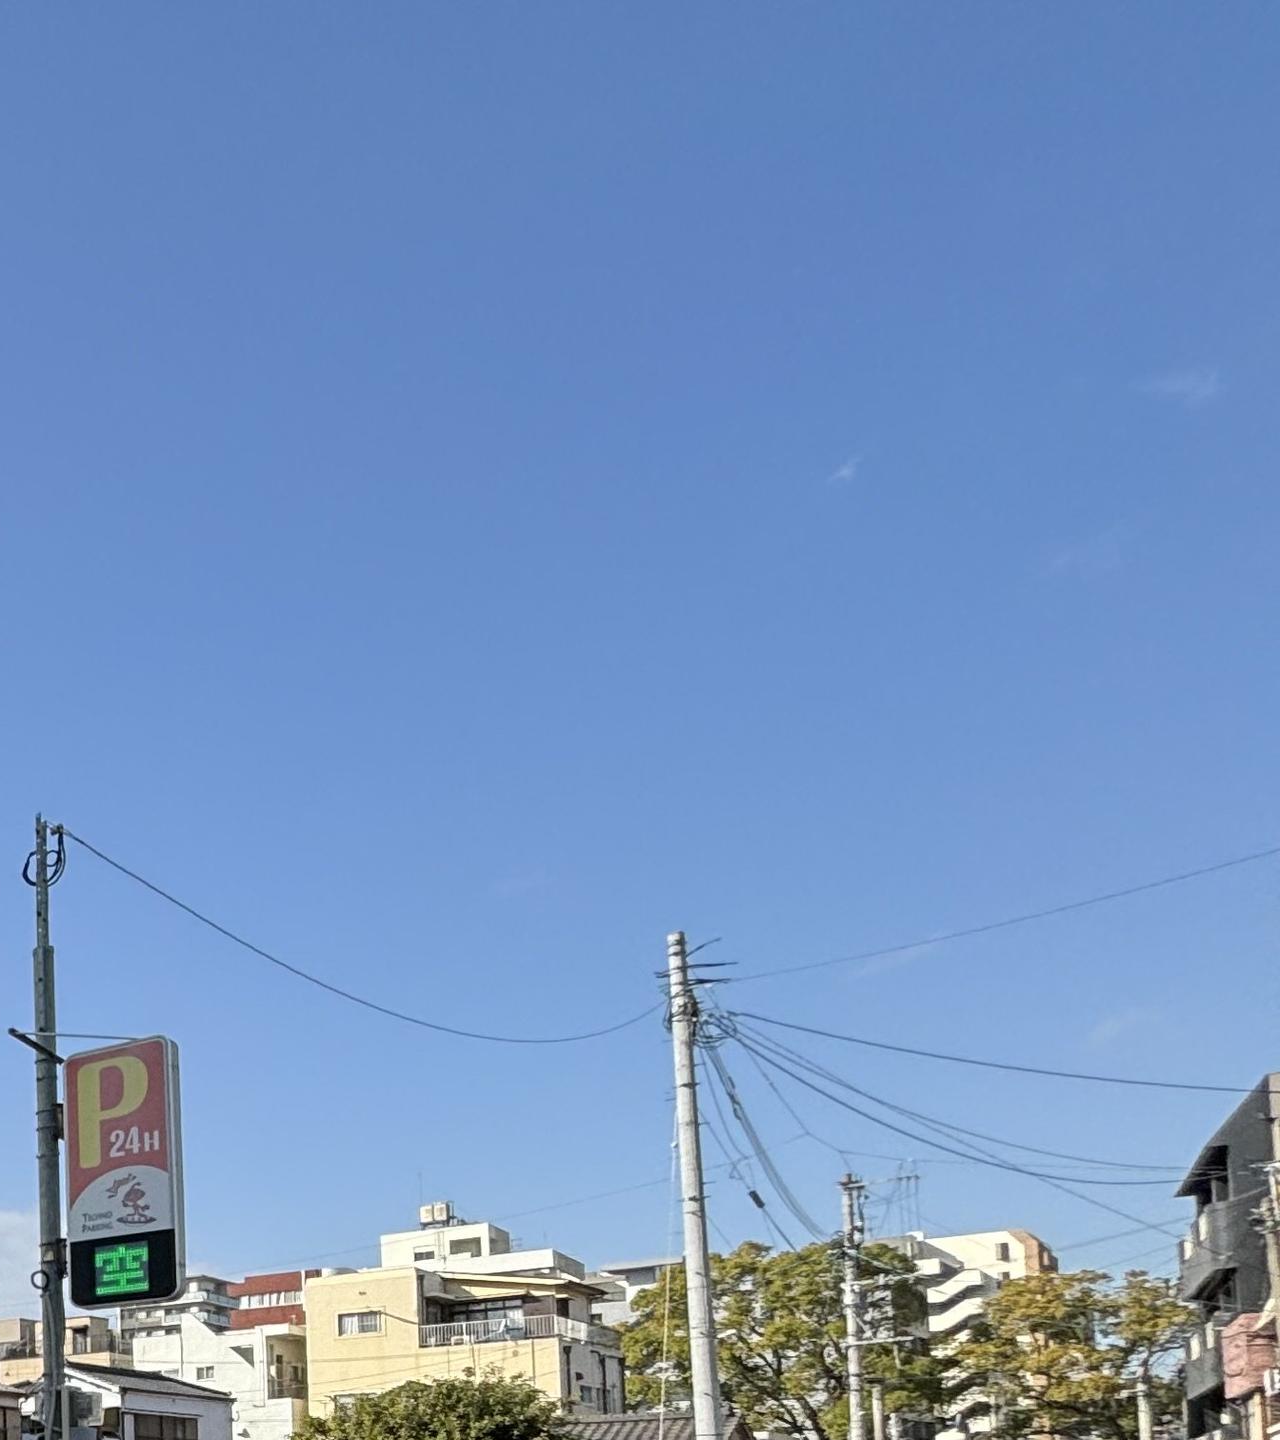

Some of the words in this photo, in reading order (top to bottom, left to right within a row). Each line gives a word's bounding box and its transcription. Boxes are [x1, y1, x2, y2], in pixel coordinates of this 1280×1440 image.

[77, 1056, 149, 1169] P
[109, 1126, 160, 1158] 24H
[95, 1245, 150, 1296] 空
